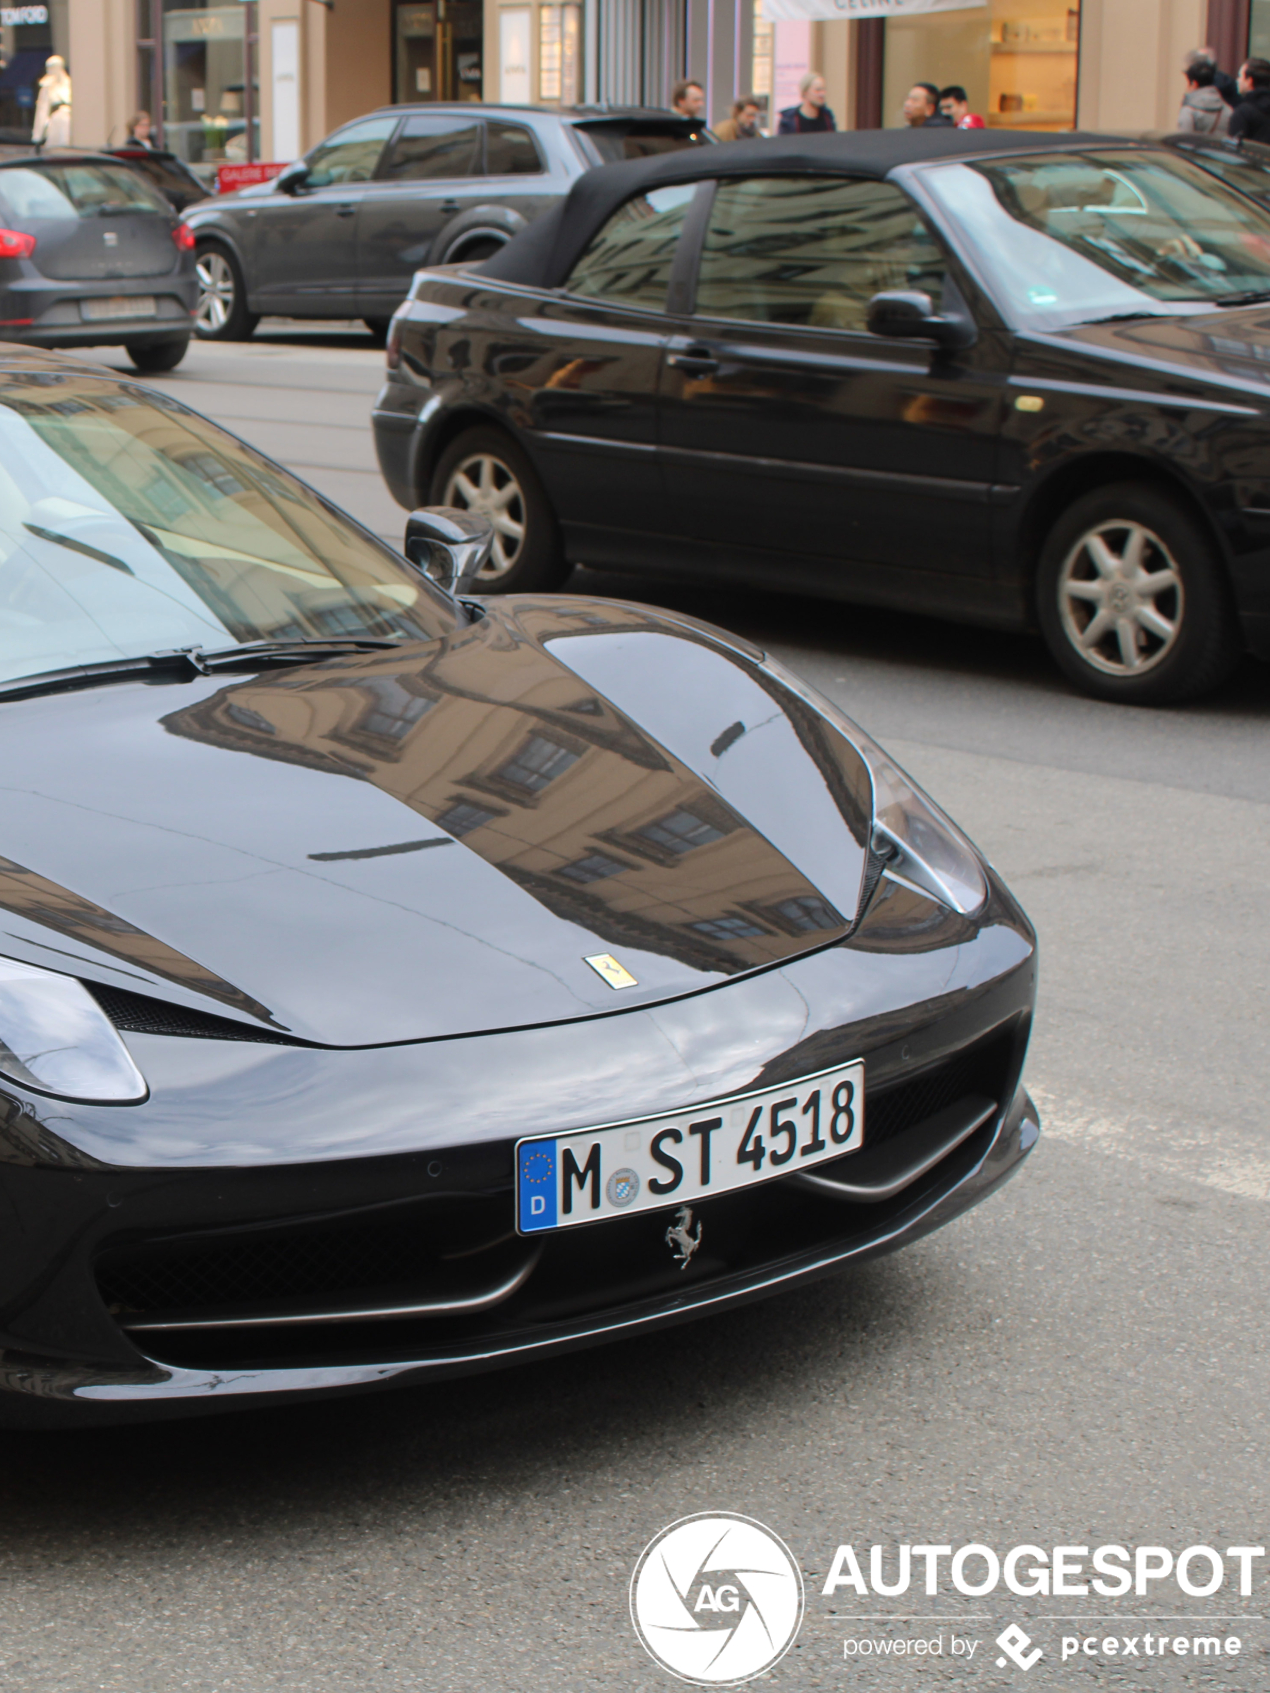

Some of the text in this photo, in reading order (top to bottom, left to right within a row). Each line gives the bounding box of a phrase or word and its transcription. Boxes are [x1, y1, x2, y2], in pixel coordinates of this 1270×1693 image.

[562, 1142, 601, 1215] M
[648, 1116, 723, 1195] ST
[737, 1080, 854, 1170] 4518
[530, 1195, 546, 1215] D
